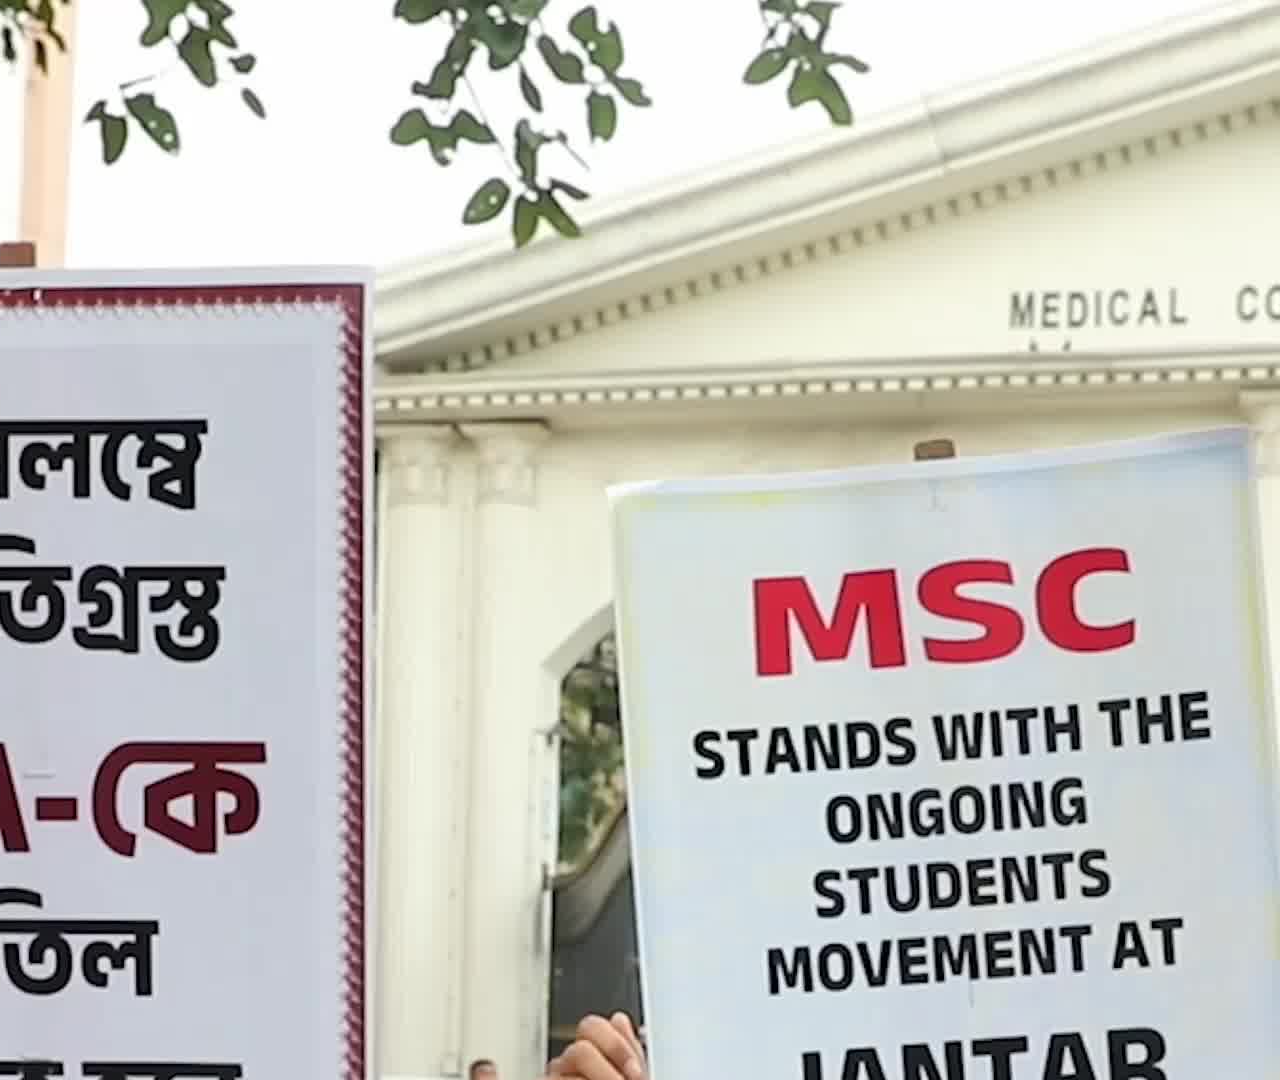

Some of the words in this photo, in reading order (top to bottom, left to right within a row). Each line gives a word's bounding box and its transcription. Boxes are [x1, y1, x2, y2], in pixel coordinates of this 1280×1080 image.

[1010, 290, 1189, 330] MEDICAL
[753, 547, 1136, 677] MSC
[694, 718, 916, 779] STANDS
[932, 704, 1081, 760] WITH
[1098, 692, 1210, 747] THE
[827, 778, 1086, 843] ONGOING
[814, 850, 1110, 918] STUDENTS
[768, 925, 1091, 995] MOVEMENT
[1113, 918, 1183, 968] AT
